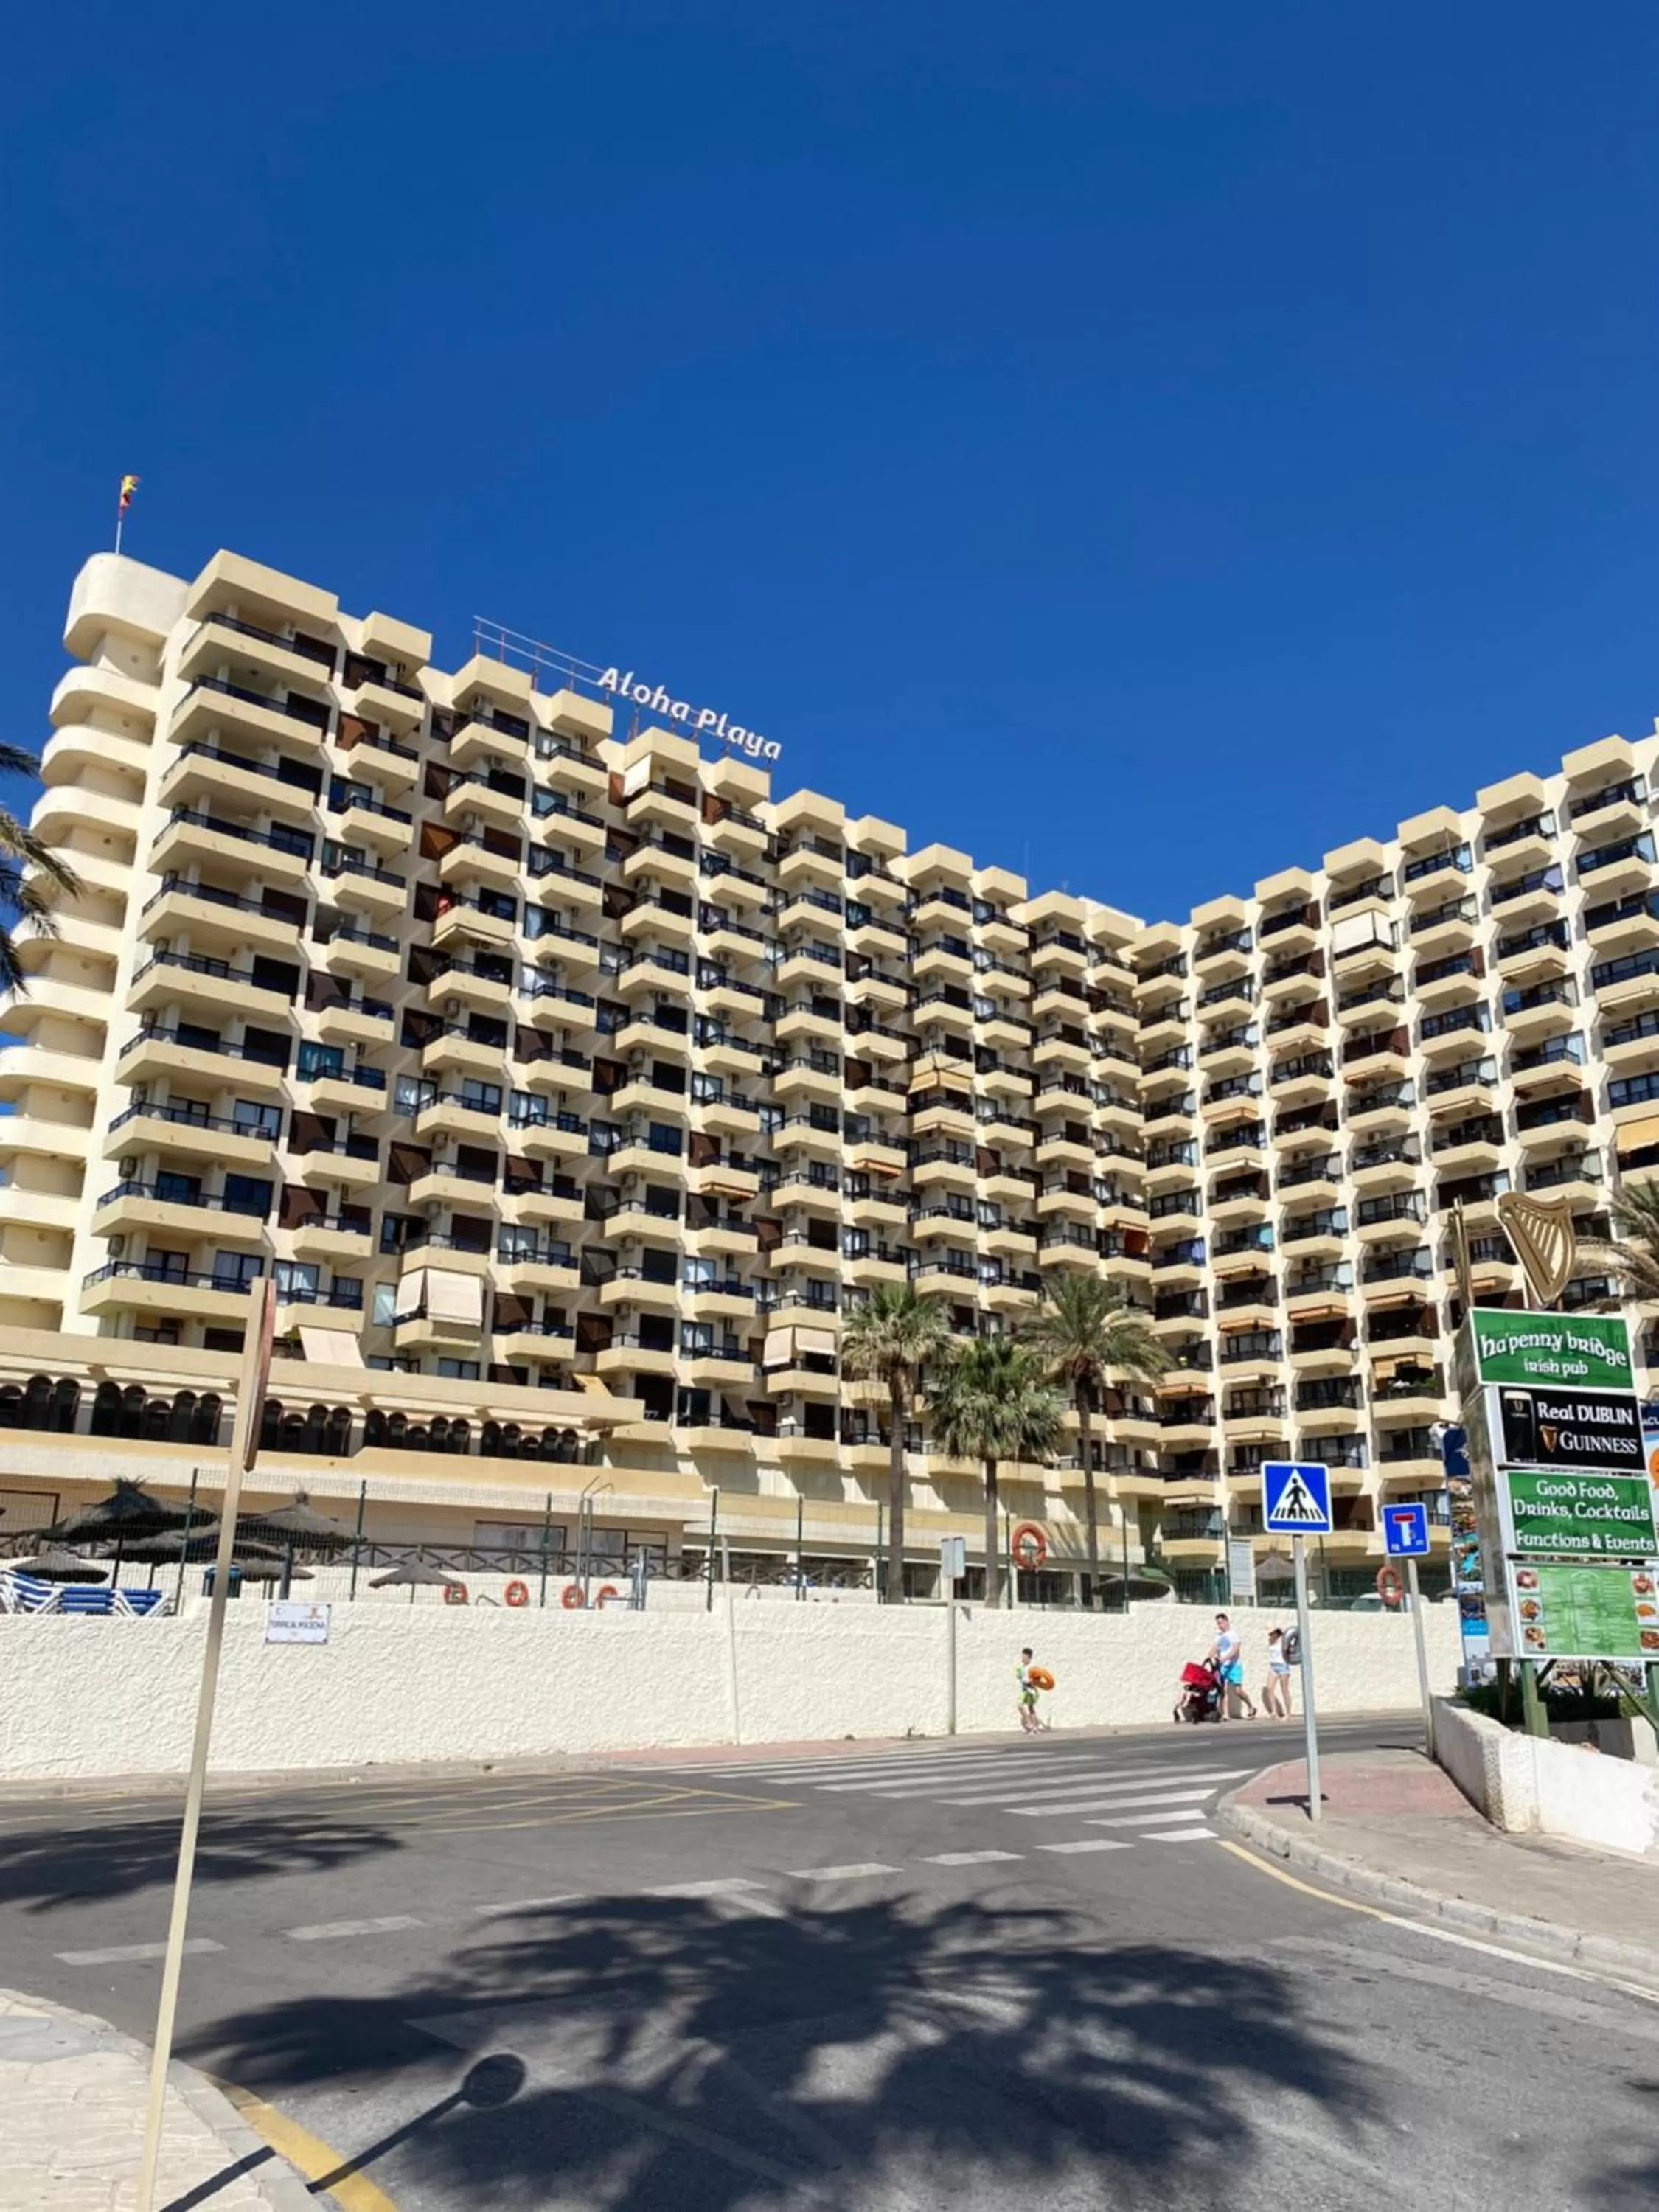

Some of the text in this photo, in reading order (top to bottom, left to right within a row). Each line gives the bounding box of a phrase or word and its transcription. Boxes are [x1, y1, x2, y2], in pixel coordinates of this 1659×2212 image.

[597, 667, 782, 759] Aloha Playa
[1480, 1330, 1627, 1366] ha'penny bridge
[1562, 1360, 1589, 1377] pub
[1537, 1402, 1574, 1421] Real
[1577, 1405, 1634, 1425] DUBLIN
[1559, 1431, 1638, 1454] GUINNESS
[1536, 1480, 1619, 1501] Good Food,
[1514, 1499, 1649, 1521] Drinks, Cocktails
[1516, 1529, 1655, 1551] Functions & Events
